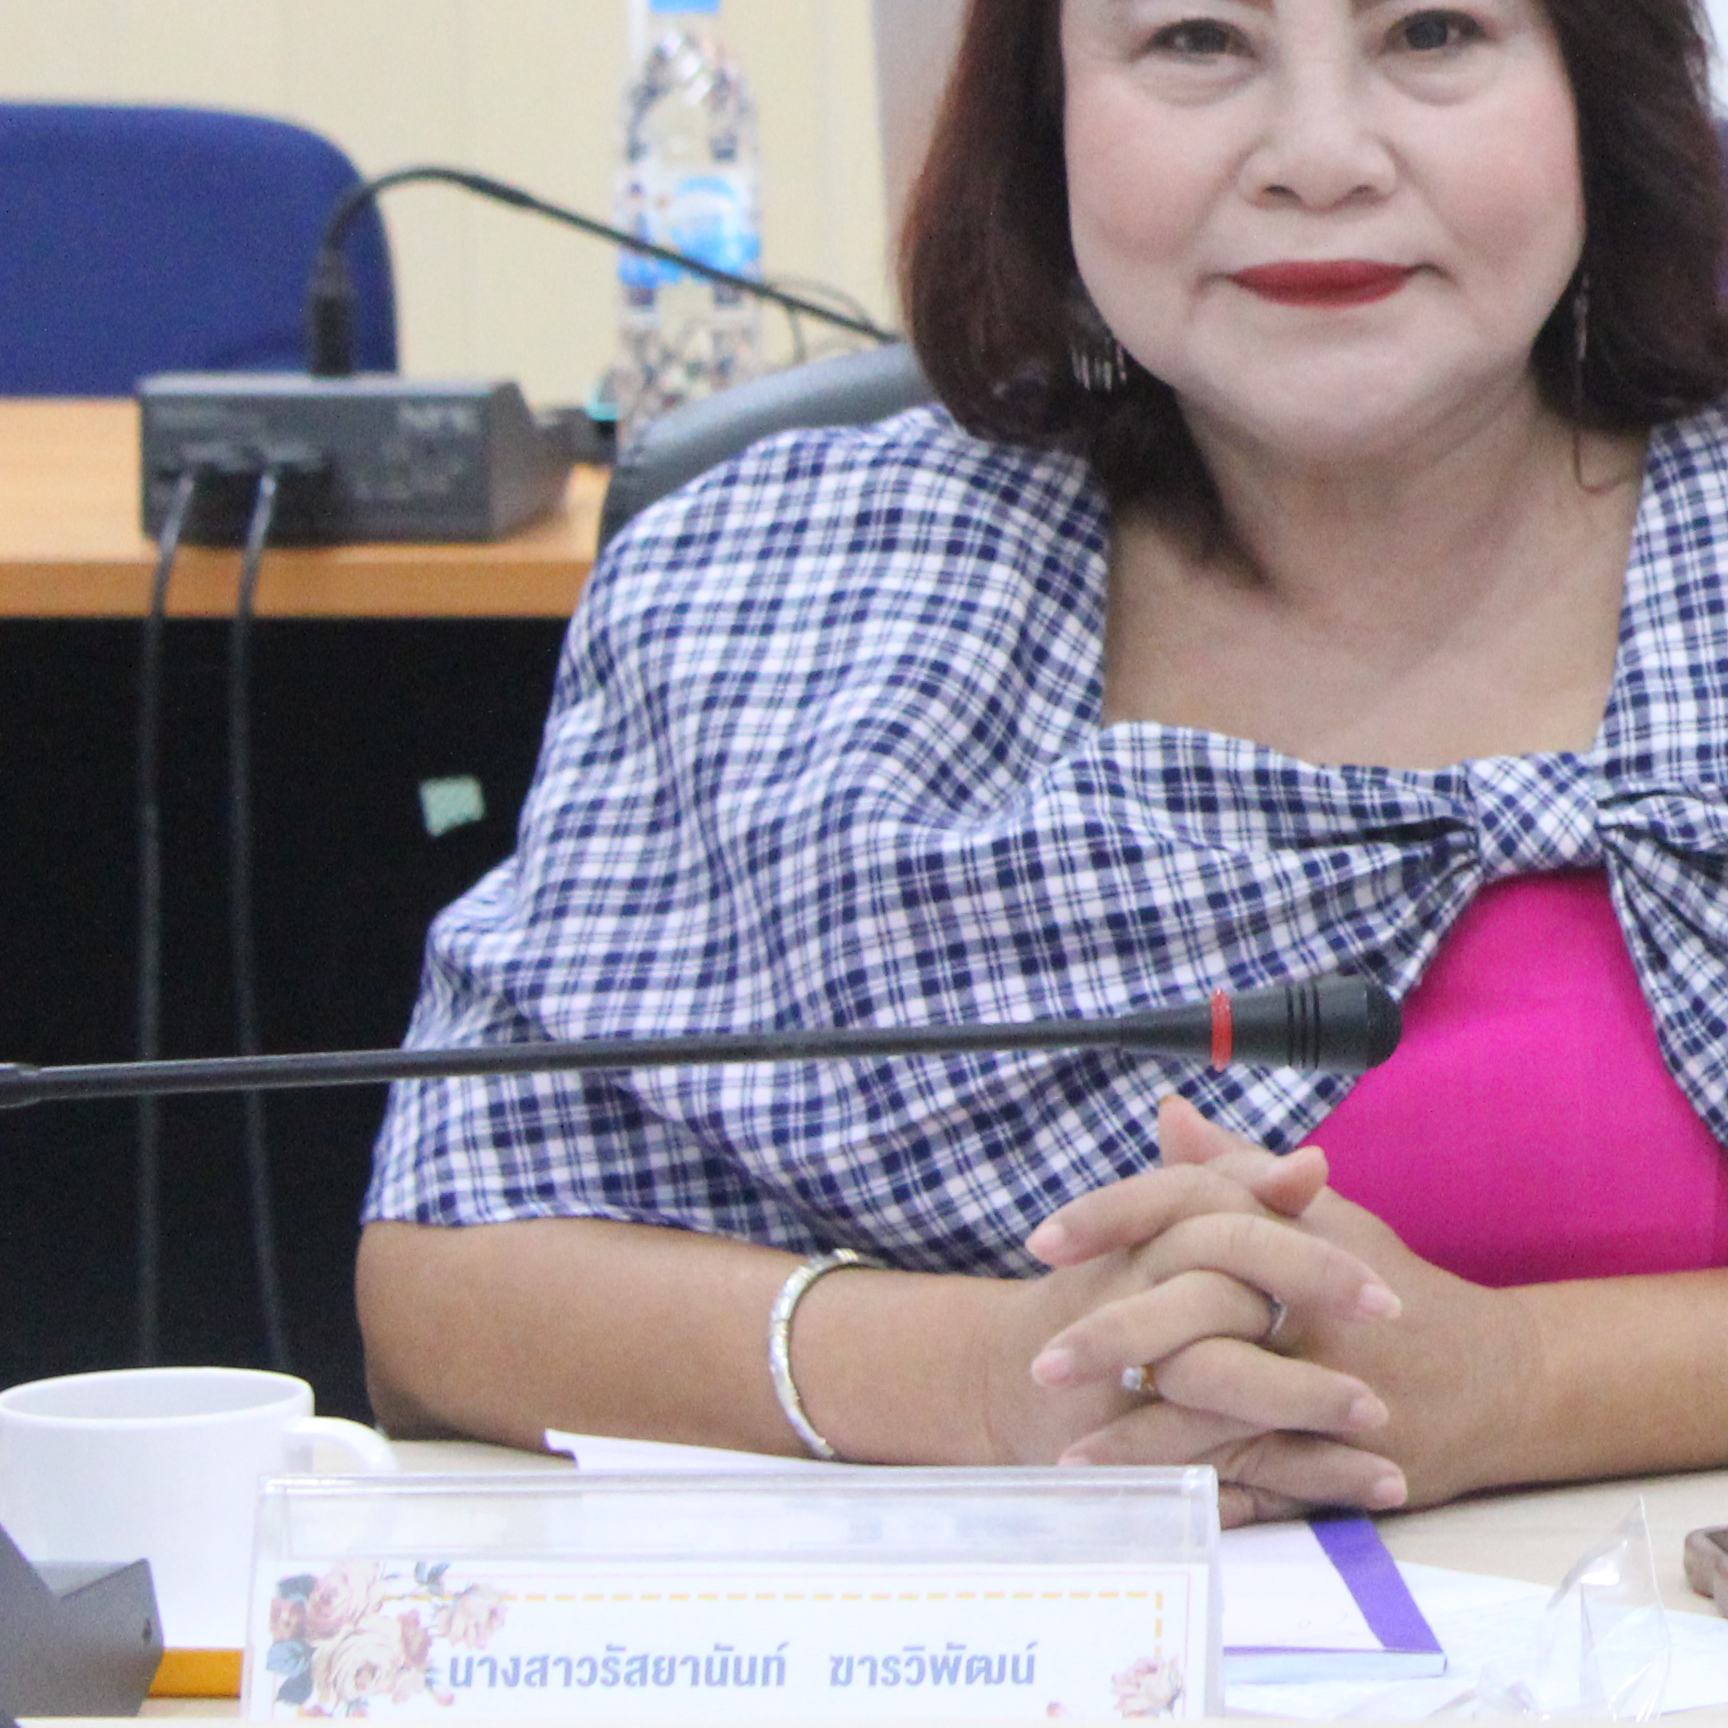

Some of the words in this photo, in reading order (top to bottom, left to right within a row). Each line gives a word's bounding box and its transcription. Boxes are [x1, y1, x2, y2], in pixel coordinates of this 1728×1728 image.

[448, 1640, 790, 1688] นางสาวรัสยานันท์
